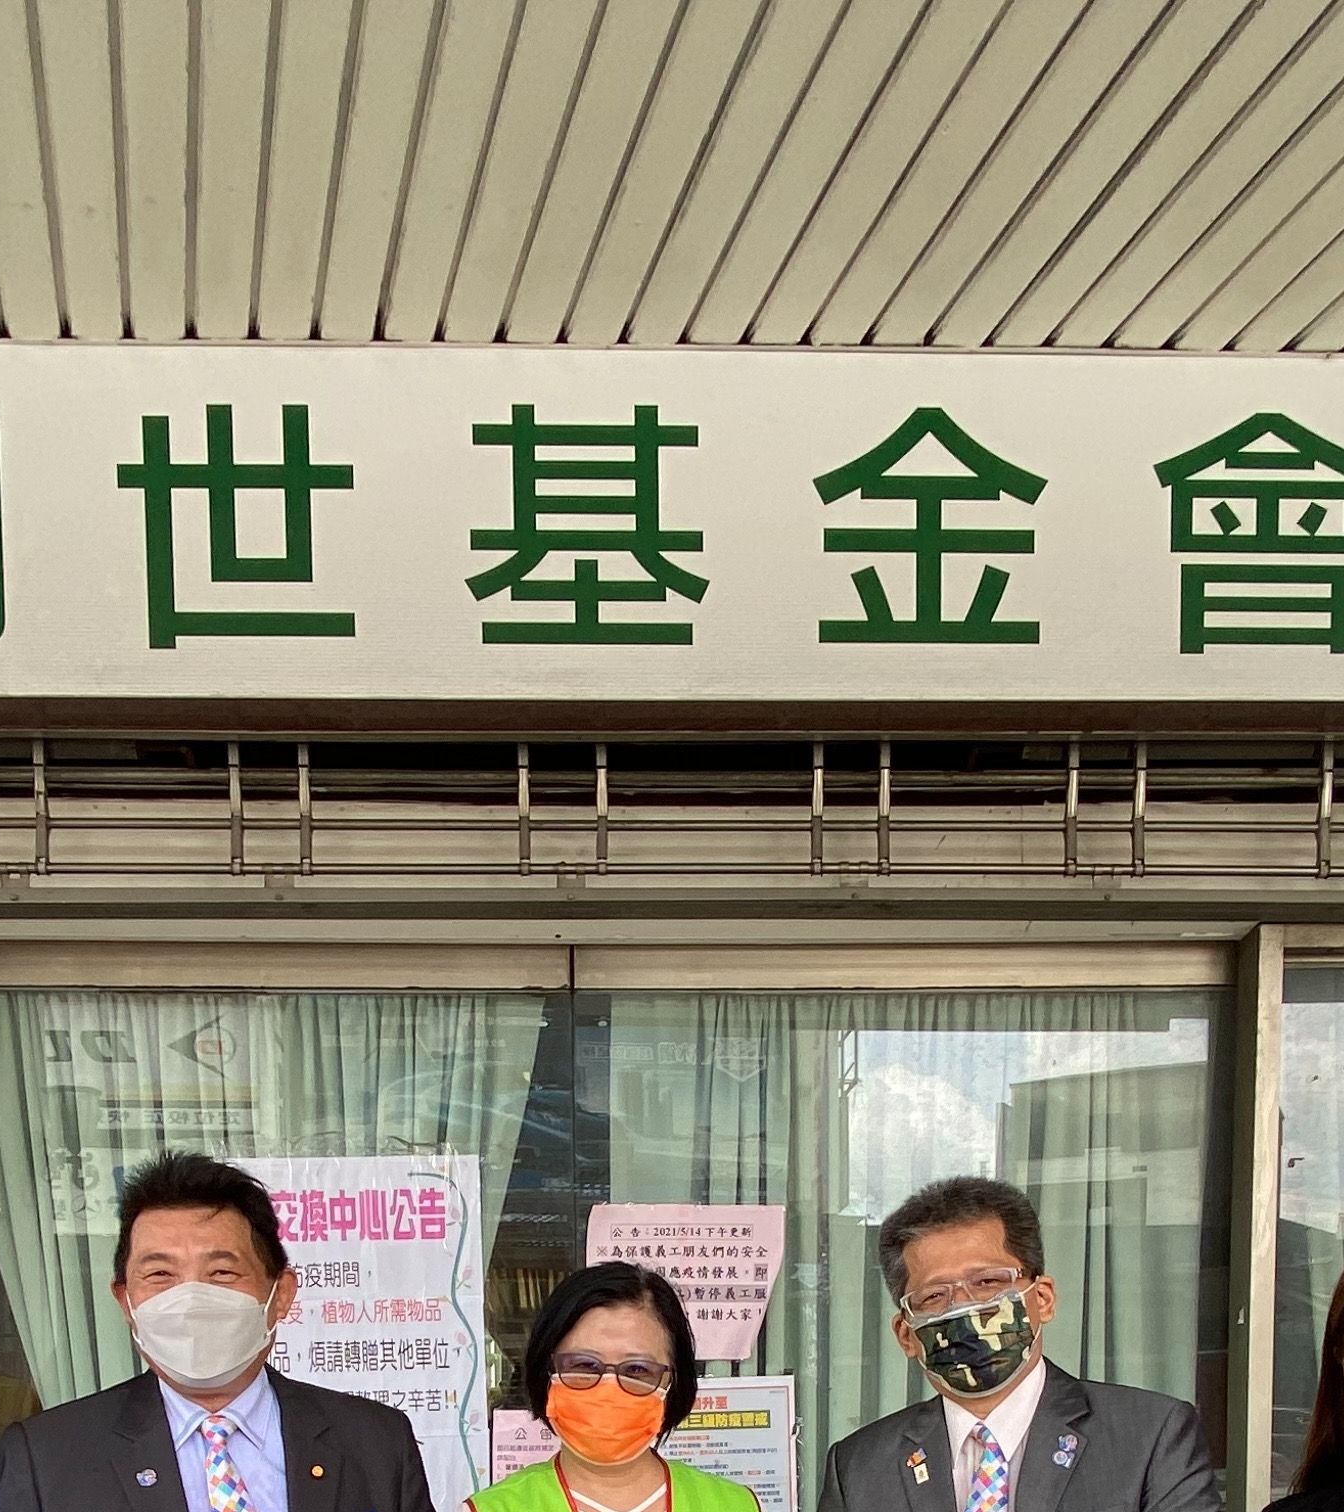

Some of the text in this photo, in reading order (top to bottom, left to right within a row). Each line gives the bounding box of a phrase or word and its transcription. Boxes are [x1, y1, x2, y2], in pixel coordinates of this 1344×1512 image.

[271, 1188, 446, 1241] 交換中心公告
